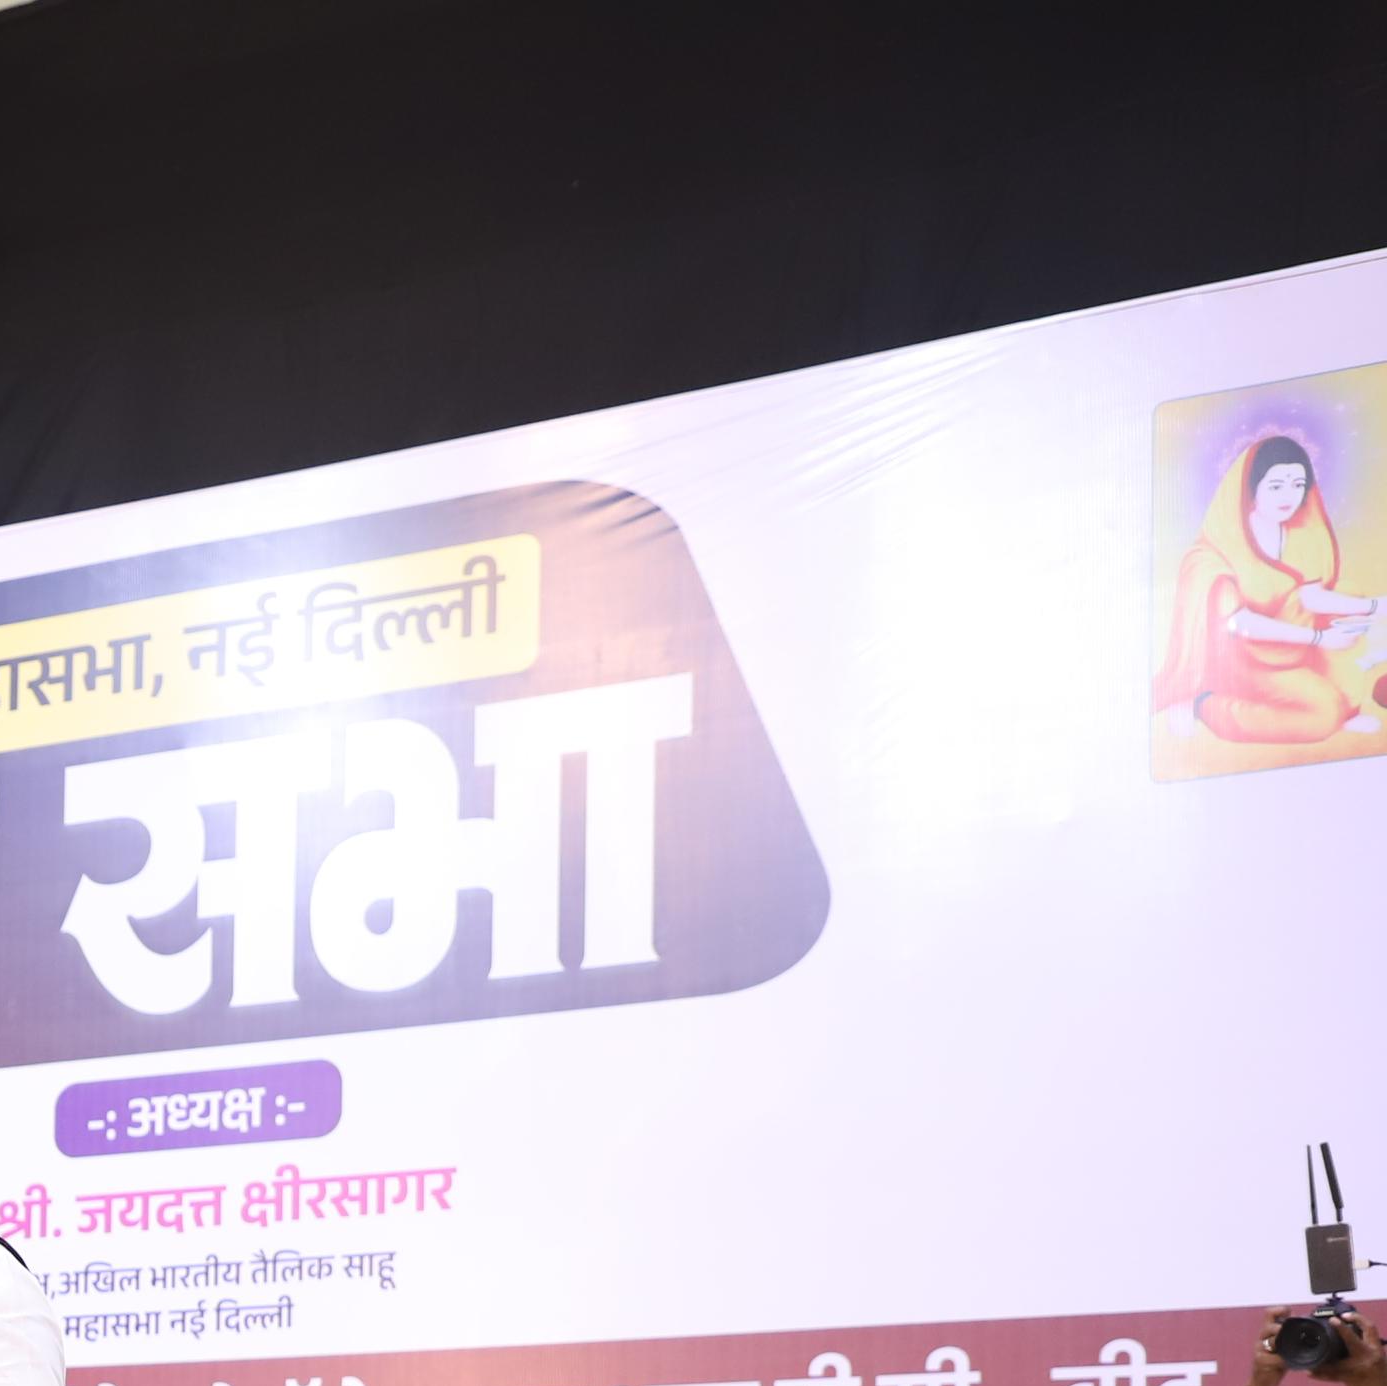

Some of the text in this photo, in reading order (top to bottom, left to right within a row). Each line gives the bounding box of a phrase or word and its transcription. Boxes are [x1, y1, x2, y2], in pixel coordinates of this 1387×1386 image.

[184, 592, 279, 686] नई
[298, 554, 505, 663] दिल्ली
[61, 672, 694, 1016] सभा
[127, 1085, 263, 1138] अध्यक्ष
[77, 1183, 225, 1238] जयदत्त
[241, 1163, 457, 1229] क्षीरसागर
[150, 1252, 241, 1291] भारतीय
[251, 1249, 333, 1284] तैलिक
[343, 1249, 398, 1290] साहू
[63, 1294, 295, 1342] महासभा नई दिल्ली
